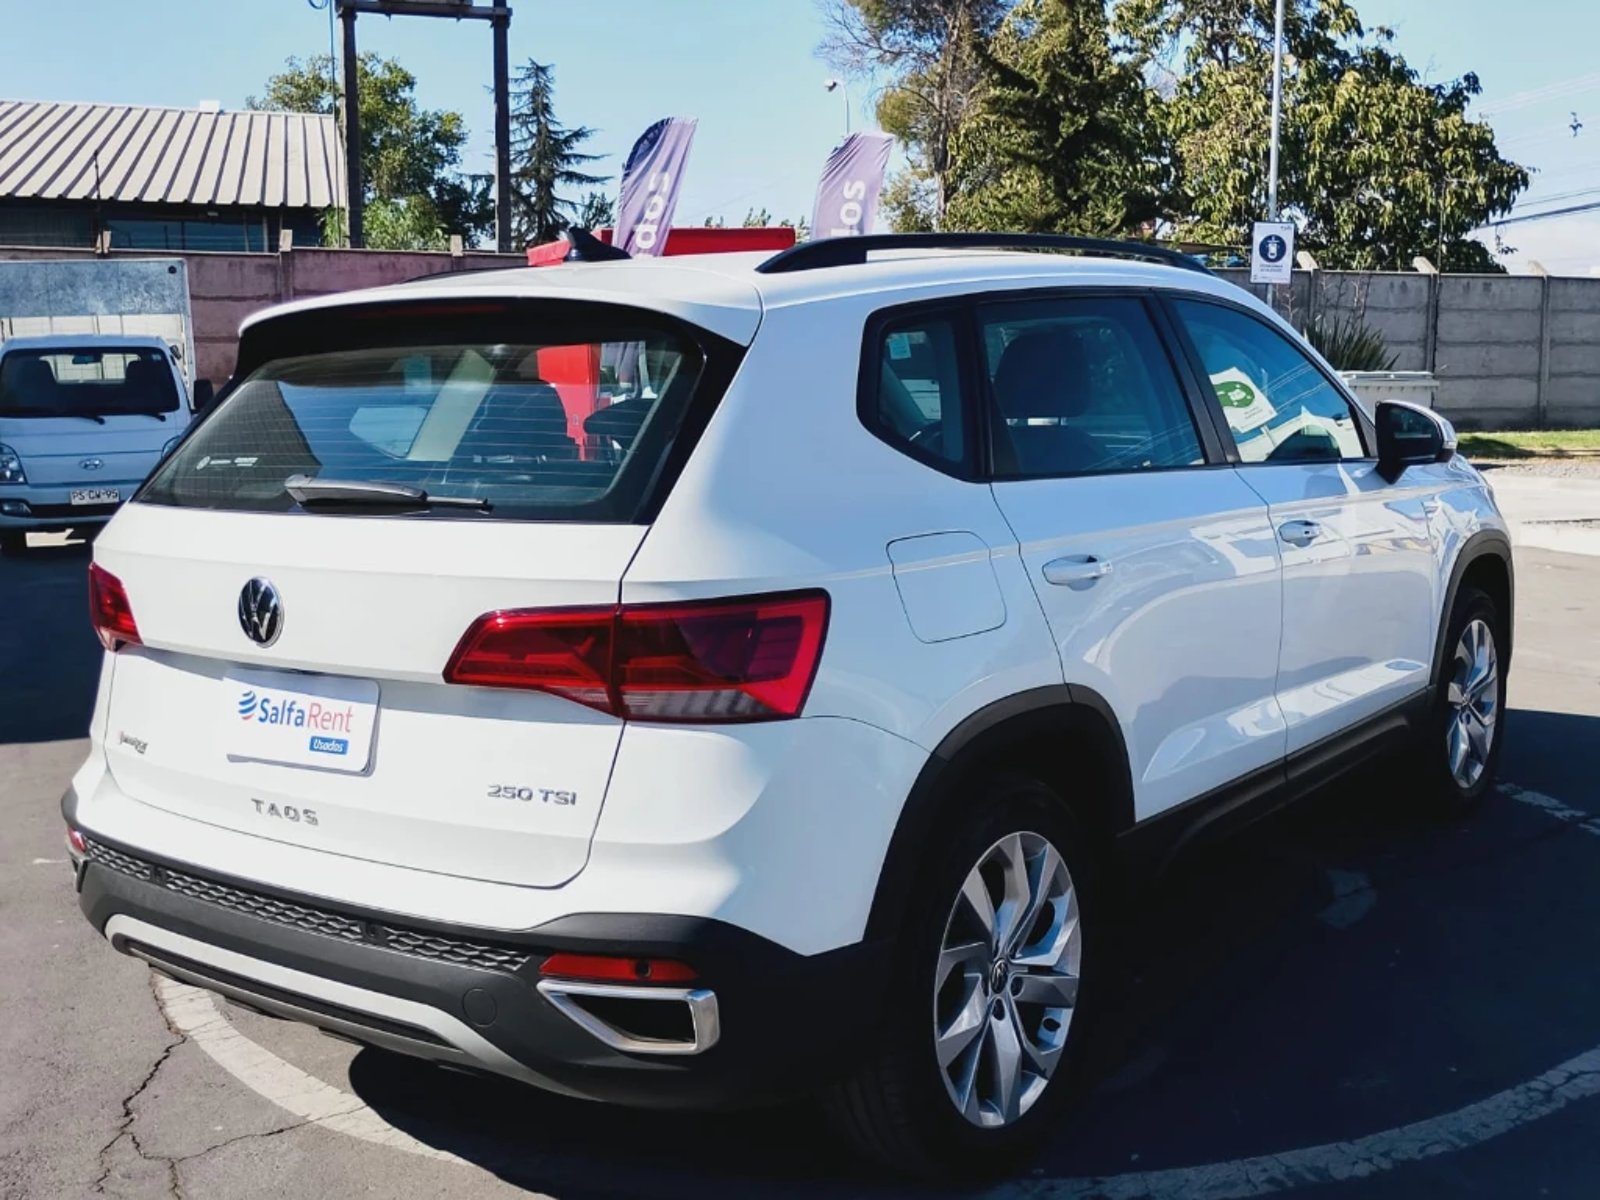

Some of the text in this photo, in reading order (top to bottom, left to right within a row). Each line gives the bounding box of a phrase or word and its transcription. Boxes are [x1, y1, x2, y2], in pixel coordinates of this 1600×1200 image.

[258, 697, 354, 734] SalfaRent
[313, 739, 344, 752] Usados
[487, 783, 577, 806] 250 TSI
[250, 797, 319, 827] TAOS
